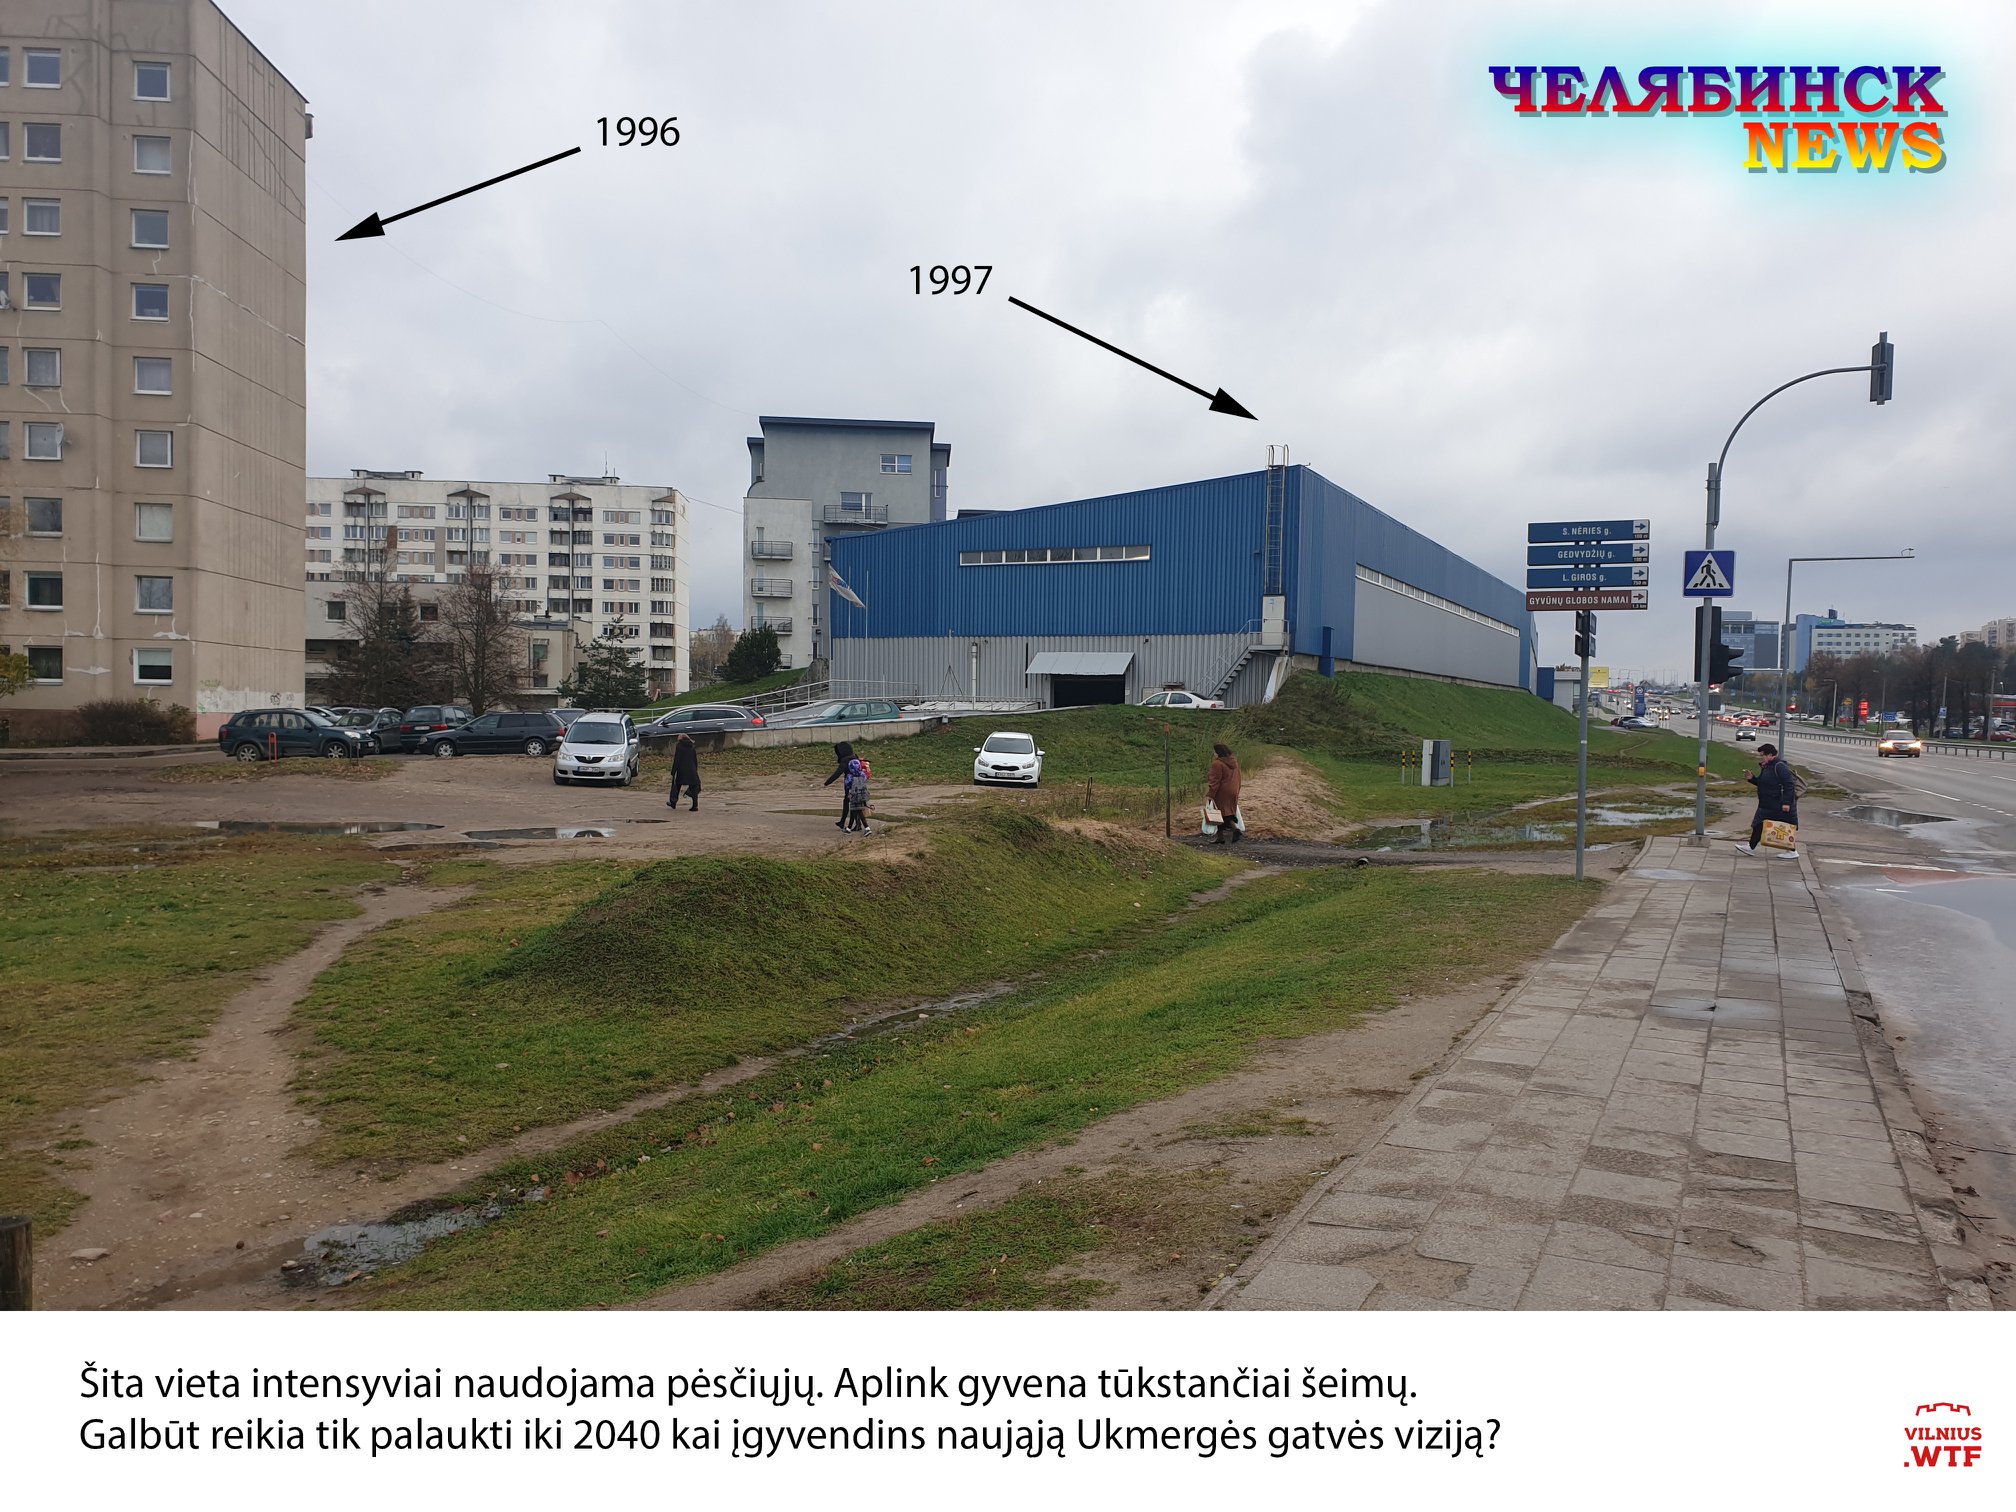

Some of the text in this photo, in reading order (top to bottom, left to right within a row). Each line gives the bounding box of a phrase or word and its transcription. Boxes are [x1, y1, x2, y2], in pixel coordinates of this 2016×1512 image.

[1562, 526, 1612, 536] S. NĖRIES g.
[1557, 549, 1616, 559] GEDVYDŽIŲ g.
[1562, 573, 1607, 583] L. GIROS g.
[1529, 595, 1629, 607] GYVŪNŲ GLOBOS NAMAI
